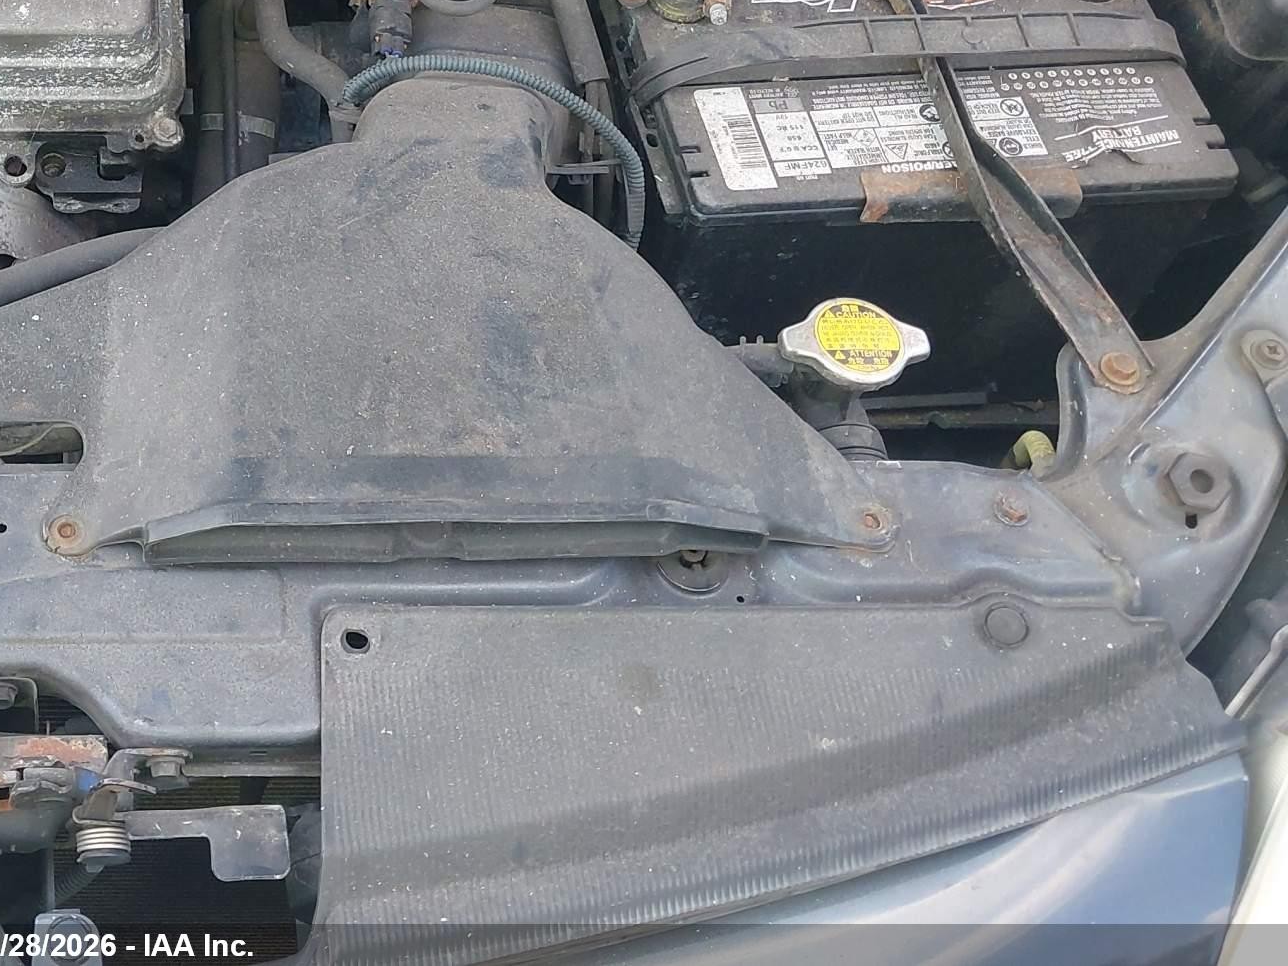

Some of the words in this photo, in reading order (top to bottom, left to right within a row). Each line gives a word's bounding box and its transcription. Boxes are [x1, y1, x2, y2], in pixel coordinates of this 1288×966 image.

[769, 100, 788, 110] Pb
[1091, 125, 1142, 140] BATTERY
[1095, 129, 1180, 149] MAINTENANCE
[849, 350, 893, 358] ATTENTION
